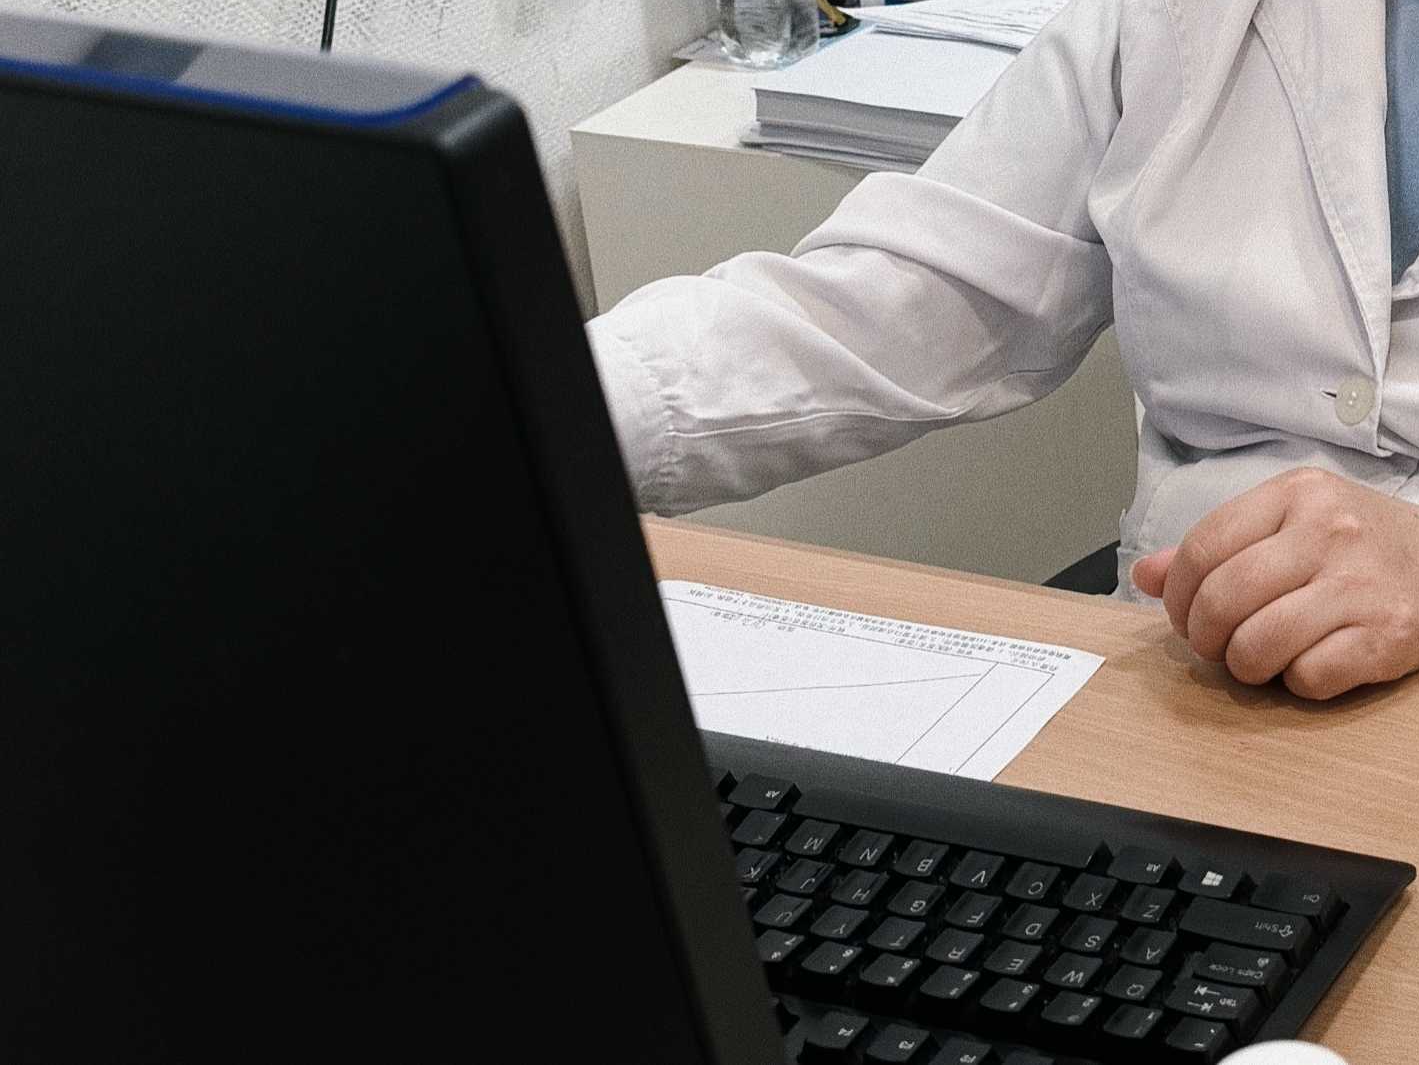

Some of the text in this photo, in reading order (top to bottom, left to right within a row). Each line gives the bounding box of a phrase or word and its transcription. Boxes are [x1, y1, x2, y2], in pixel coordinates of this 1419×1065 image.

[804, 838, 823, 850] M
[860, 849, 877, 860] N
[917, 859, 933, 871] B
[972, 871, 985, 883] V
[1028, 882, 1043, 894] C
[852, 889, 869, 900] H
[1086, 893, 1101, 906] X
[910, 900, 925, 912] G
[1143, 905, 1160, 918] Z
[967, 912, 984, 925] F
[834, 924, 845, 934] Y
[1026, 924, 1041, 935] D
[890, 936, 904, 946] T
[1085, 936, 1100, 947] S
[948, 948, 965, 959] R
[1147, 948, 1160, 959] A
[1007, 959, 1024, 970] E
[1062, 971, 1083, 983] W
[1127, 984, 1144, 996] Q
